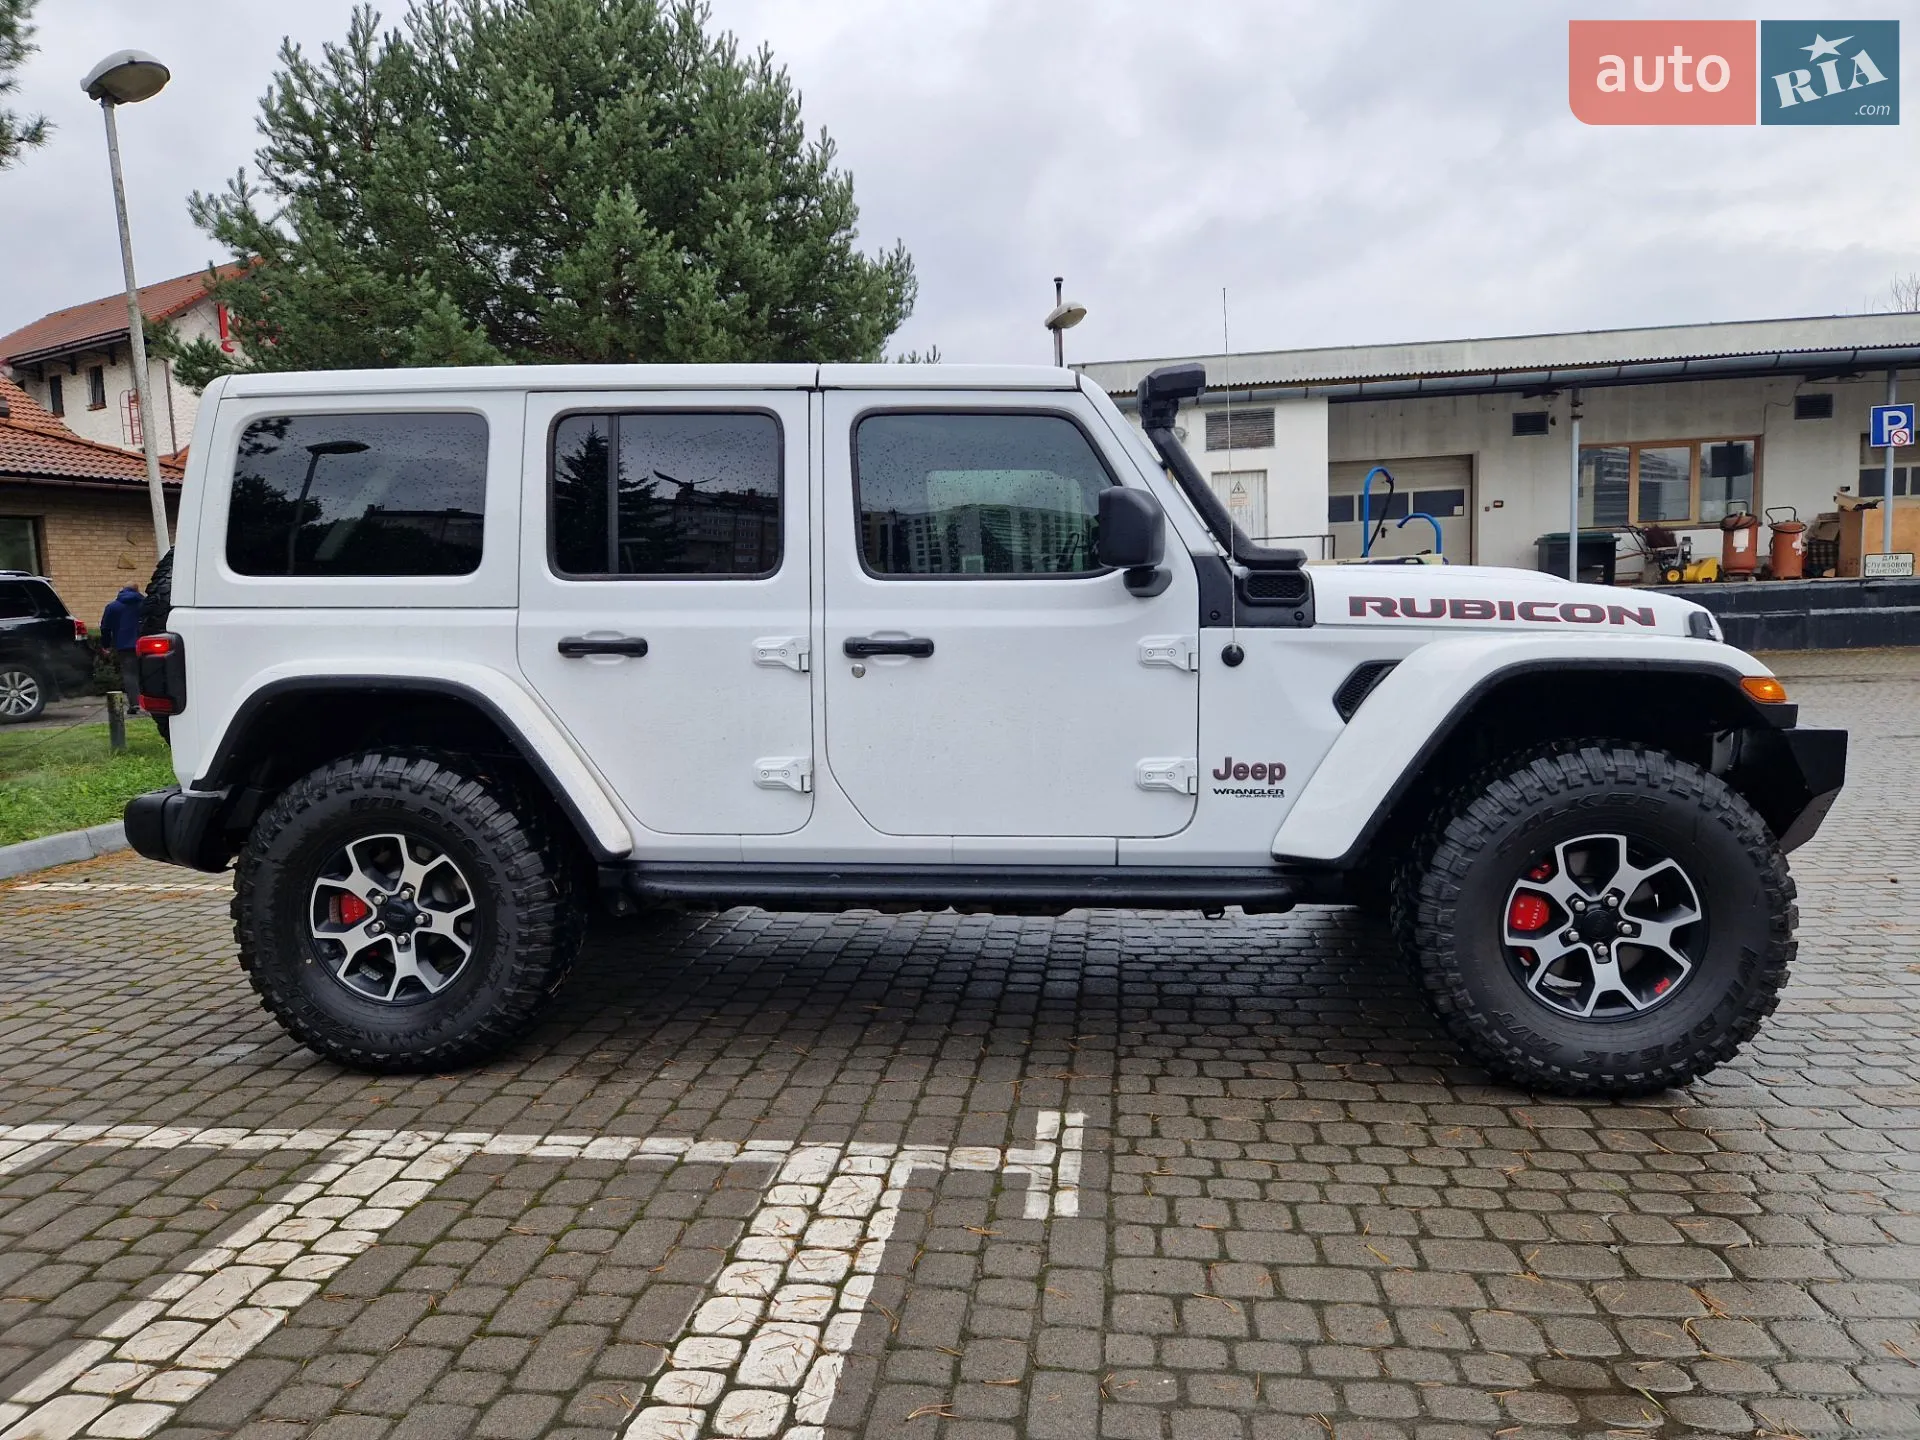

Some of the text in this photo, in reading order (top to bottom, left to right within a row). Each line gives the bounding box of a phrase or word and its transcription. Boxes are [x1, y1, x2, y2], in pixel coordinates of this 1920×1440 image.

[1882, 410, 1907, 443] P
[1348, 596, 1656, 626] RUBICON
[1213, 757, 1287, 785] Jeep
